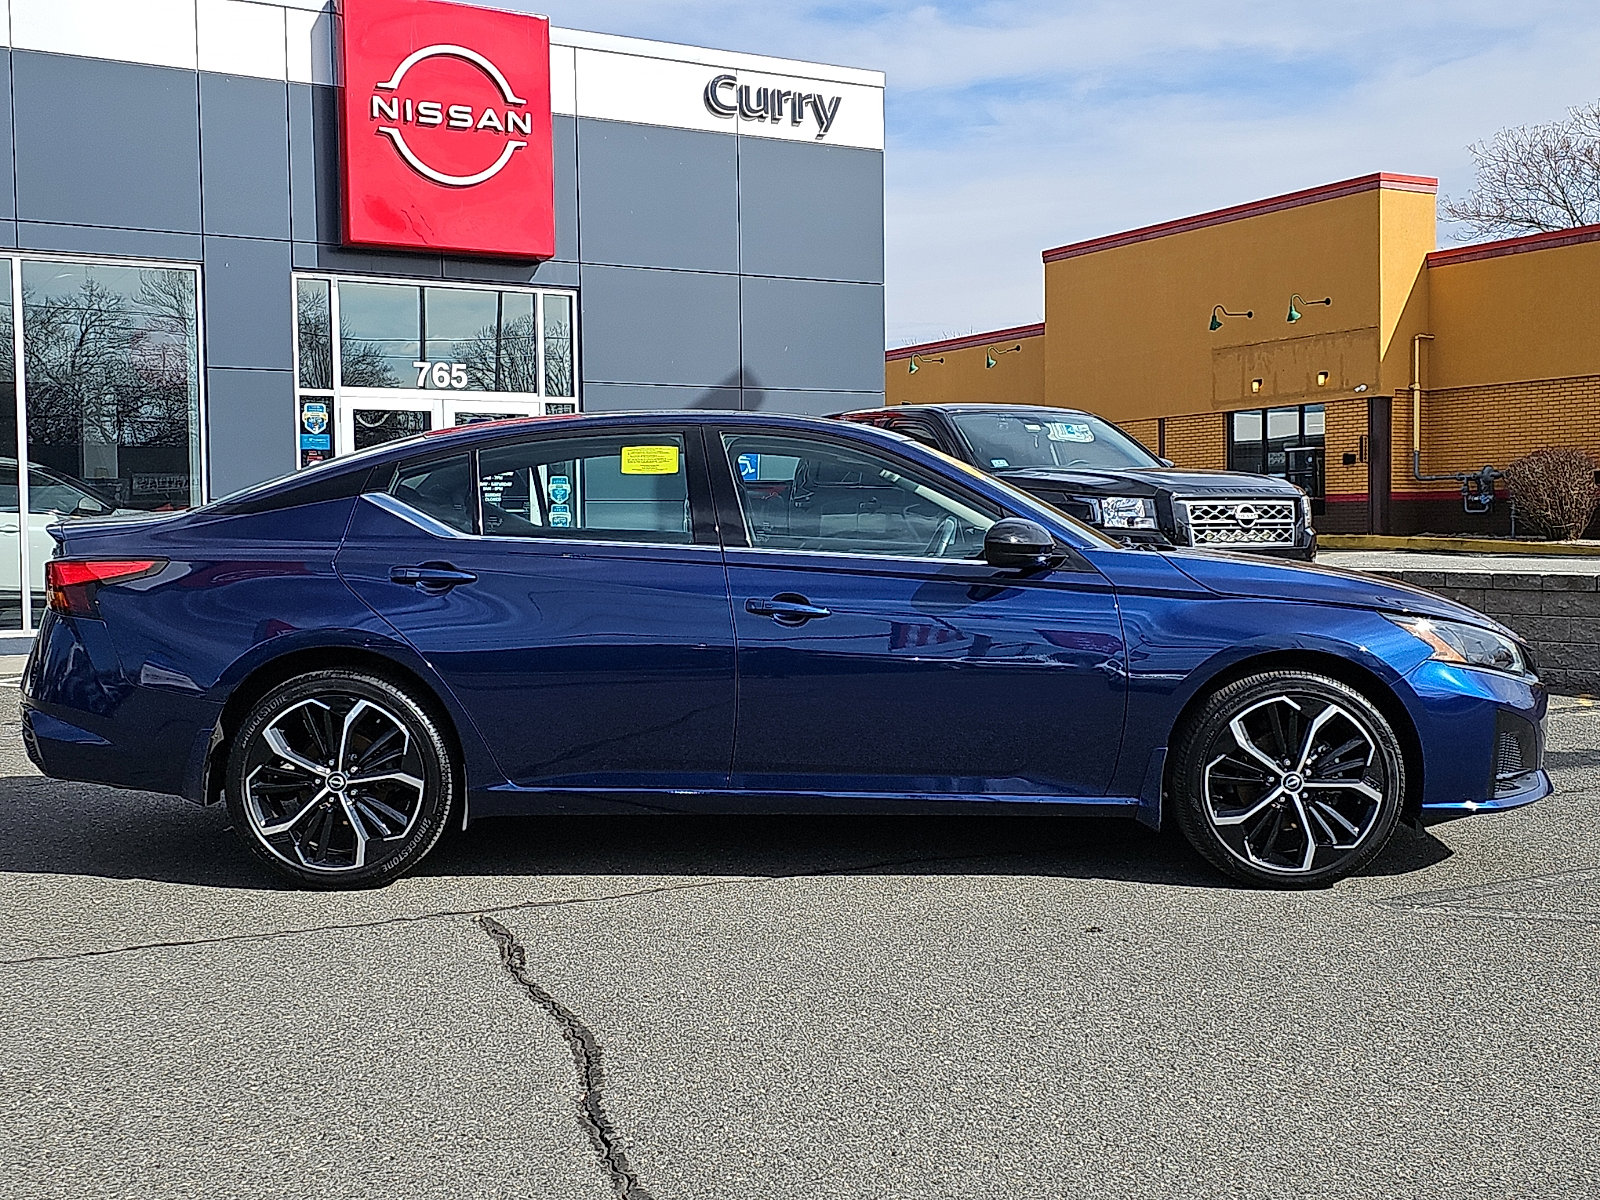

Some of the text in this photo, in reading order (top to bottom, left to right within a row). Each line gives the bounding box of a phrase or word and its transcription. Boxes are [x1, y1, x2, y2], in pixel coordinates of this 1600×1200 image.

[371, 95, 532, 135] NISSAN
[705, 74, 842, 137] Curry
[412, 361, 468, 389] 765
[381, 817, 432, 873] BRIDGESTONE
